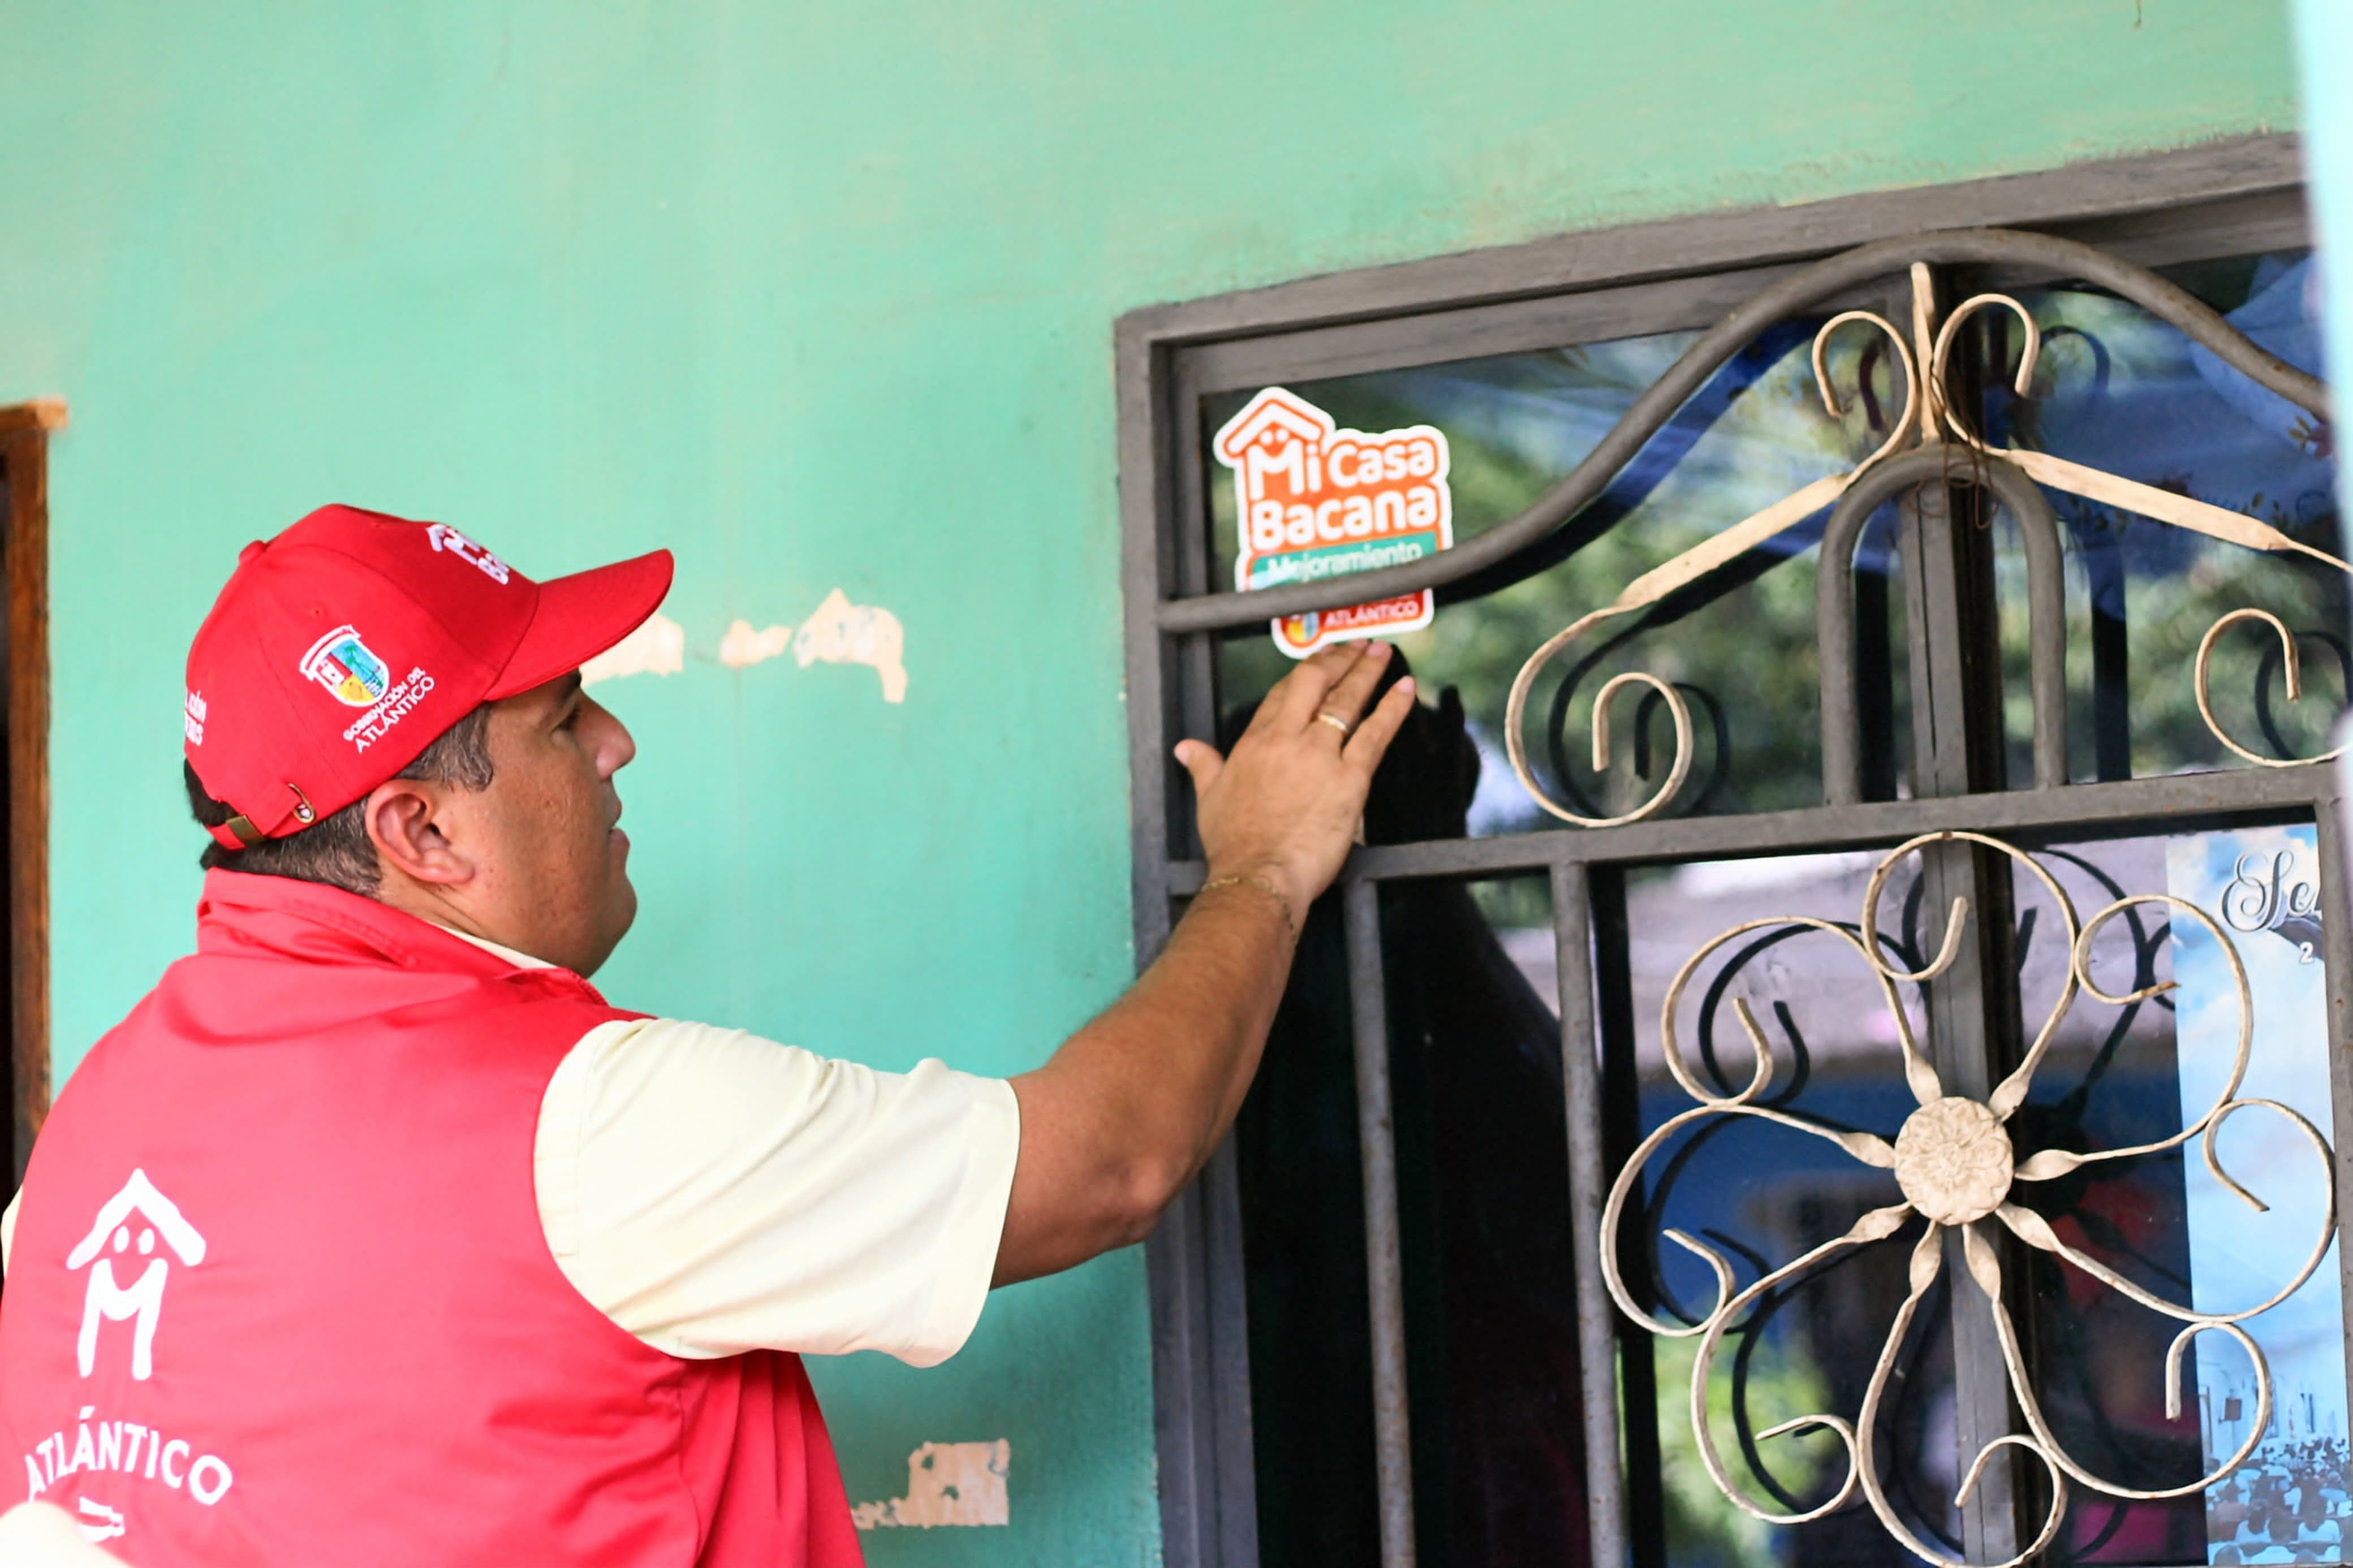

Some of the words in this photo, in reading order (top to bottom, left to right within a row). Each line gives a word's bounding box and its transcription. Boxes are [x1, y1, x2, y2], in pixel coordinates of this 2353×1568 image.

[1246, 438, 1322, 502] Mi
[1327, 440, 1436, 487] Casa
[1251, 485, 1437, 551] Bacana
[1267, 541, 1423, 583] Mejoramiento
[1323, 599, 1420, 627] ATLÁNTICO
[343, 680, 408, 741] GOBERNACIÓN
[407, 667, 426, 685] DEL
[355, 676, 435, 754] ATLÁNTICO
[24, 1405, 233, 1505] ATLÁNTICO
